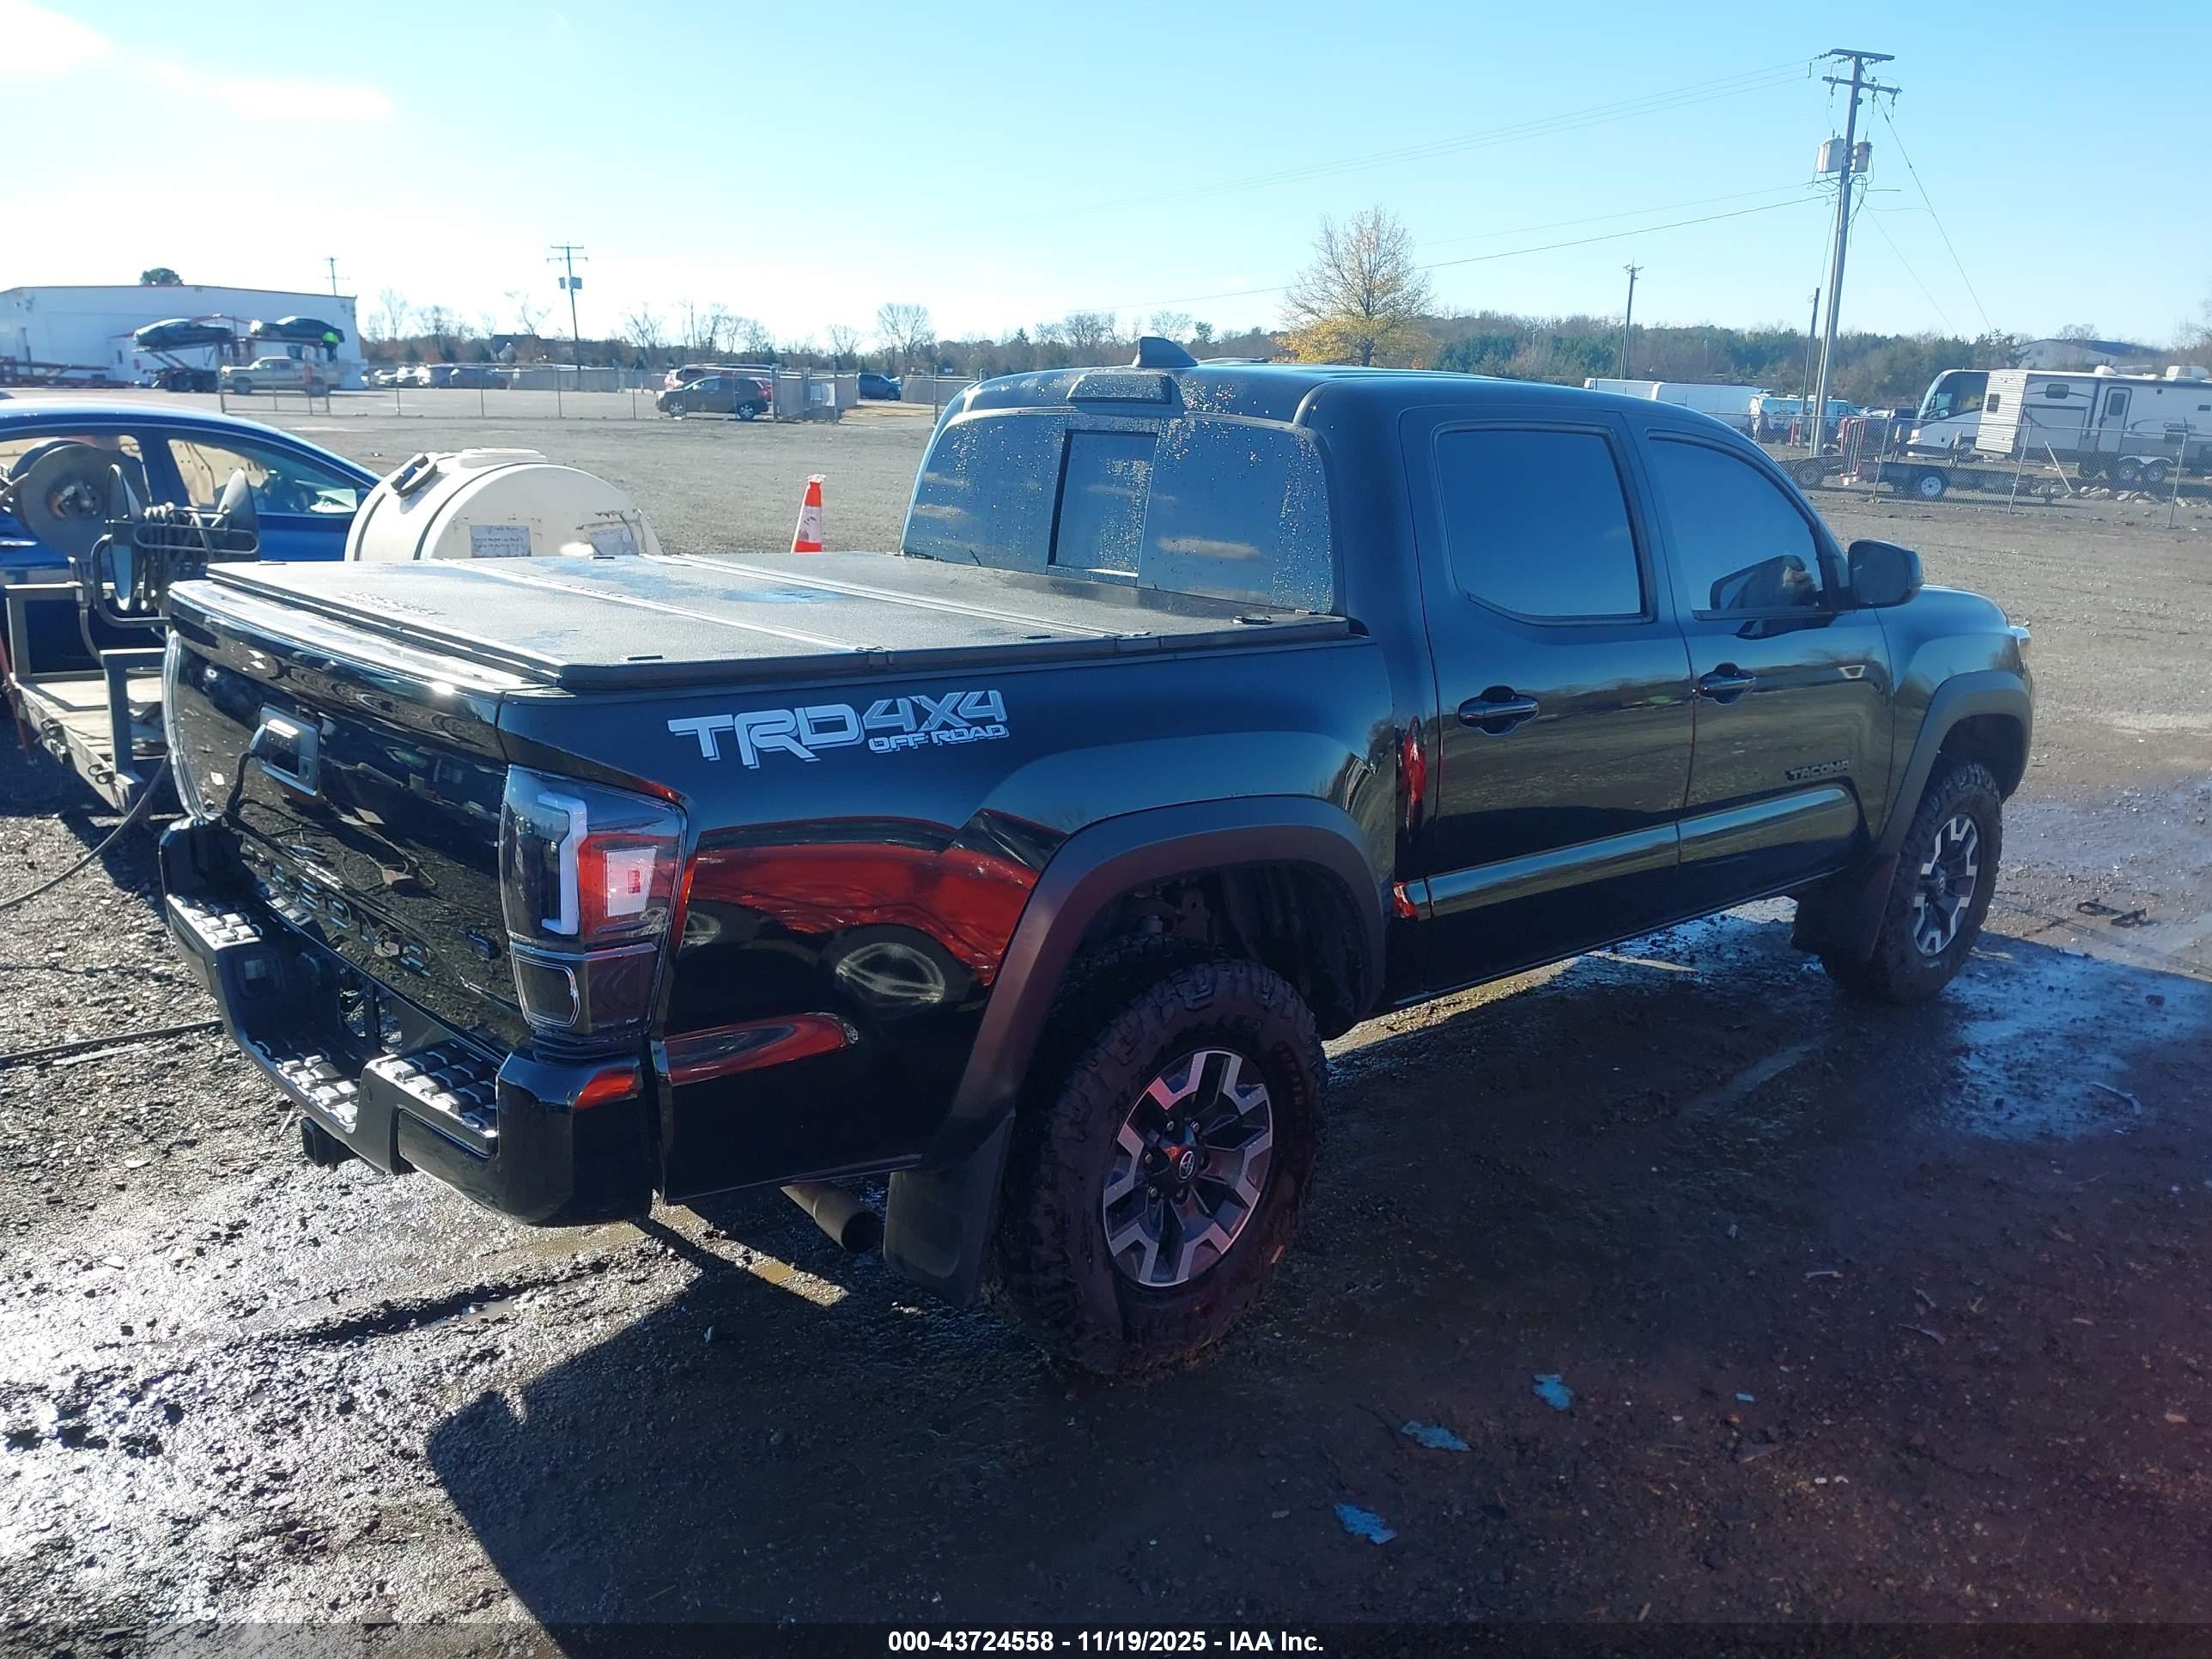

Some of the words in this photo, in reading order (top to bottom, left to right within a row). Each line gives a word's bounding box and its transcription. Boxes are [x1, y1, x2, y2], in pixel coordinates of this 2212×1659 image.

[668, 702, 865, 769] TRD
[863, 689, 1008, 732] 4X4
[867, 733, 927, 754] OFF
[931, 724, 1010, 746] ROAD
[1789, 759, 1852, 781] TACOMA
